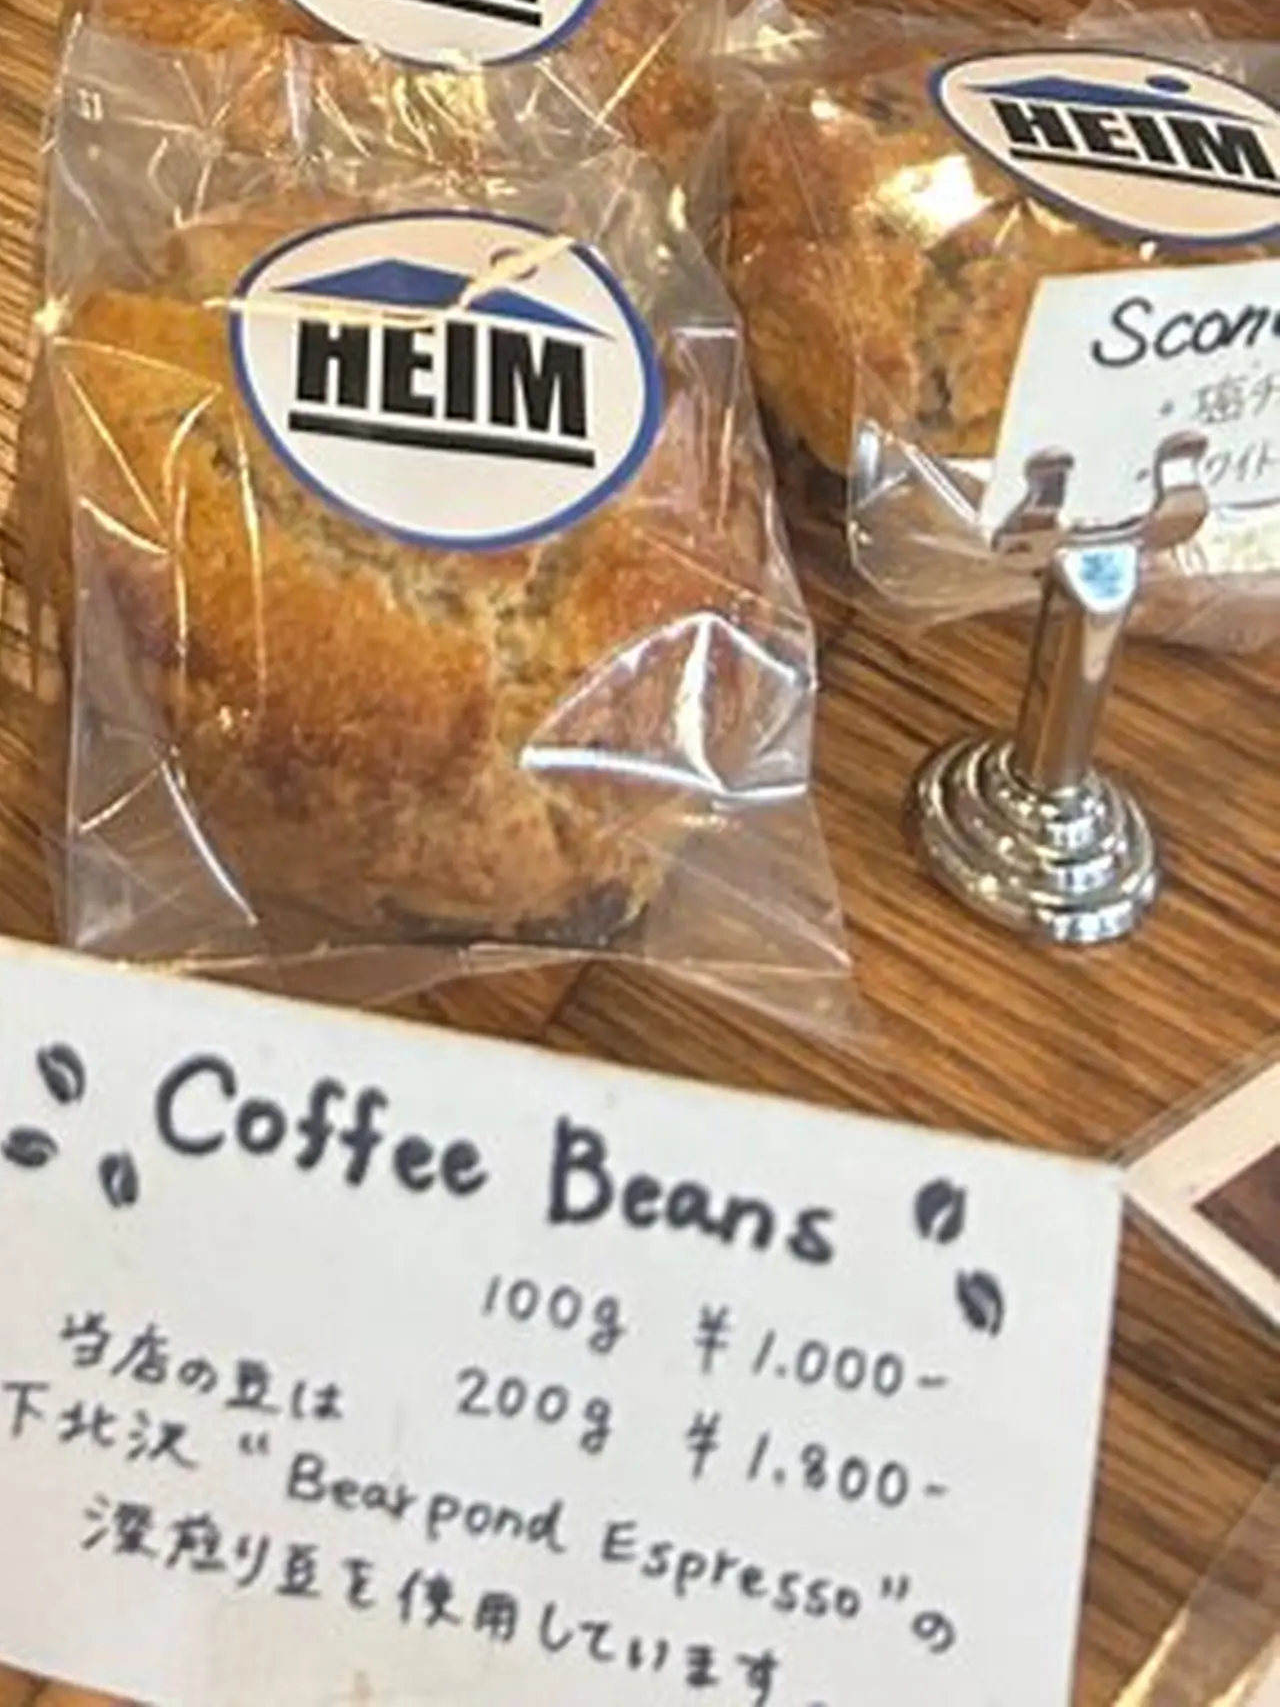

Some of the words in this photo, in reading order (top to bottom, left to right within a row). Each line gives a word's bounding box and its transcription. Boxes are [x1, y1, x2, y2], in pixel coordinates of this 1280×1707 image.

[991, 100, 1277, 181] HEIM
[1091, 295, 1280, 368] Scon
[294, 321, 589, 439] HEIM
[154, 1053, 490, 1195] Coffee
[547, 1116, 835, 1263] Beans
[482, 1274, 626, 1355] 100g
[59, 1311, 344, 1420] 当店の豆は
[455, 1366, 611, 1455] 200g
